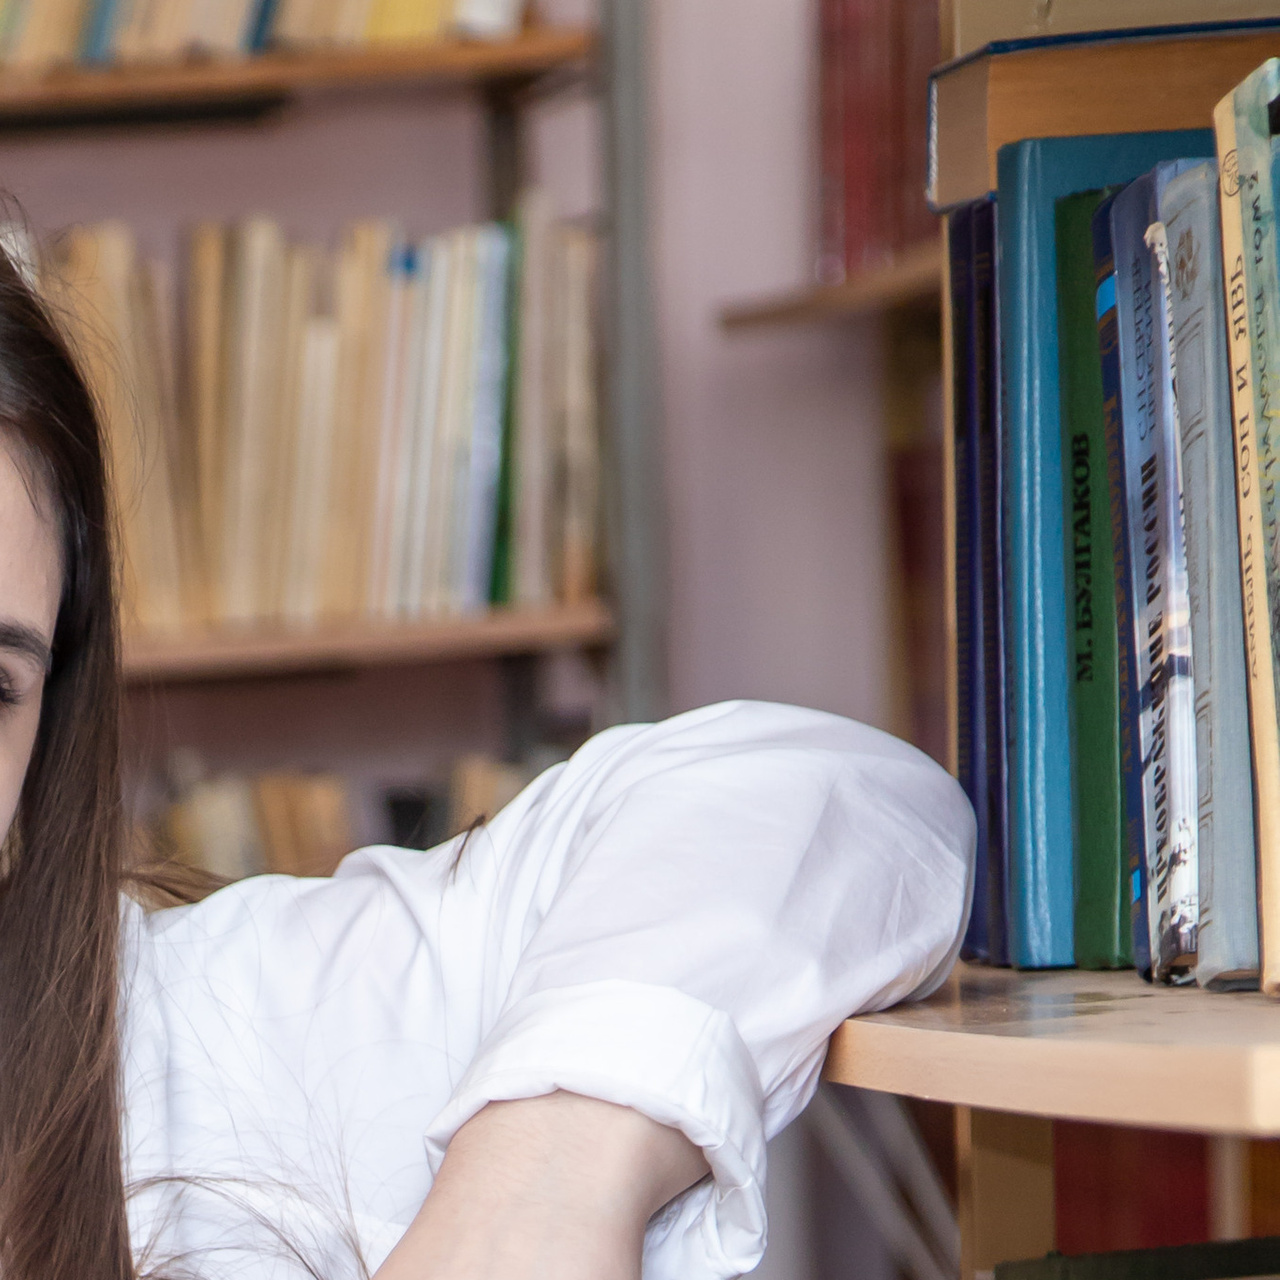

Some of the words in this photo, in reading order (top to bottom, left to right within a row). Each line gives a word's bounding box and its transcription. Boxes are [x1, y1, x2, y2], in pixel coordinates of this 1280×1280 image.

[1230, 255, 1247, 341] ЯВЬ
[1235, 361, 1248, 392] И
[1238, 413, 1252, 498] СОН
[1070, 433, 1093, 630] БУЛГАКОВ
[1140, 453, 1162, 605] РОССИИ
[1075, 640, 1093, 682] М.
